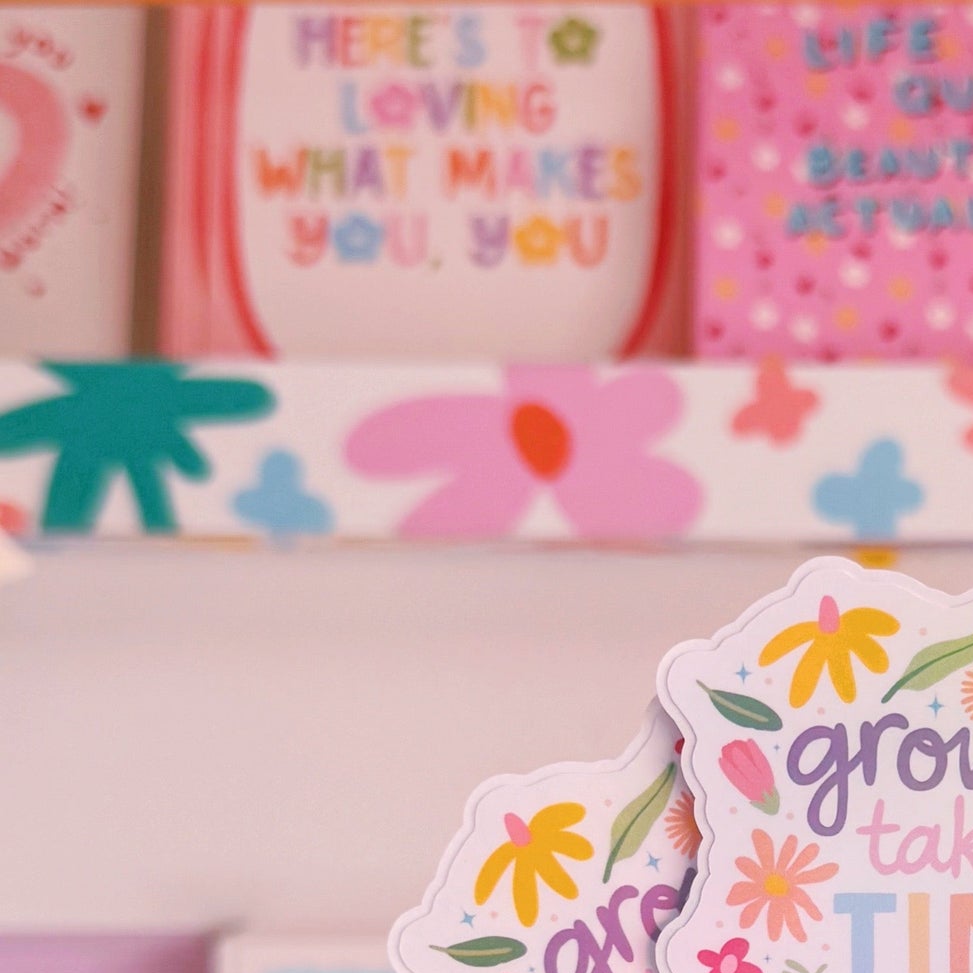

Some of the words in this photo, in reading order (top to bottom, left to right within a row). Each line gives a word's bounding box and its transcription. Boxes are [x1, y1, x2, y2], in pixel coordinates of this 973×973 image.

[297, 14, 486, 68] HERE'S
[804, 17, 942, 71] LIFE
[339, 81, 557, 134] LOVING
[254, 146, 414, 198] WHAT
[445, 146, 644, 201] MAKES
[471, 213, 608, 268] YOU
